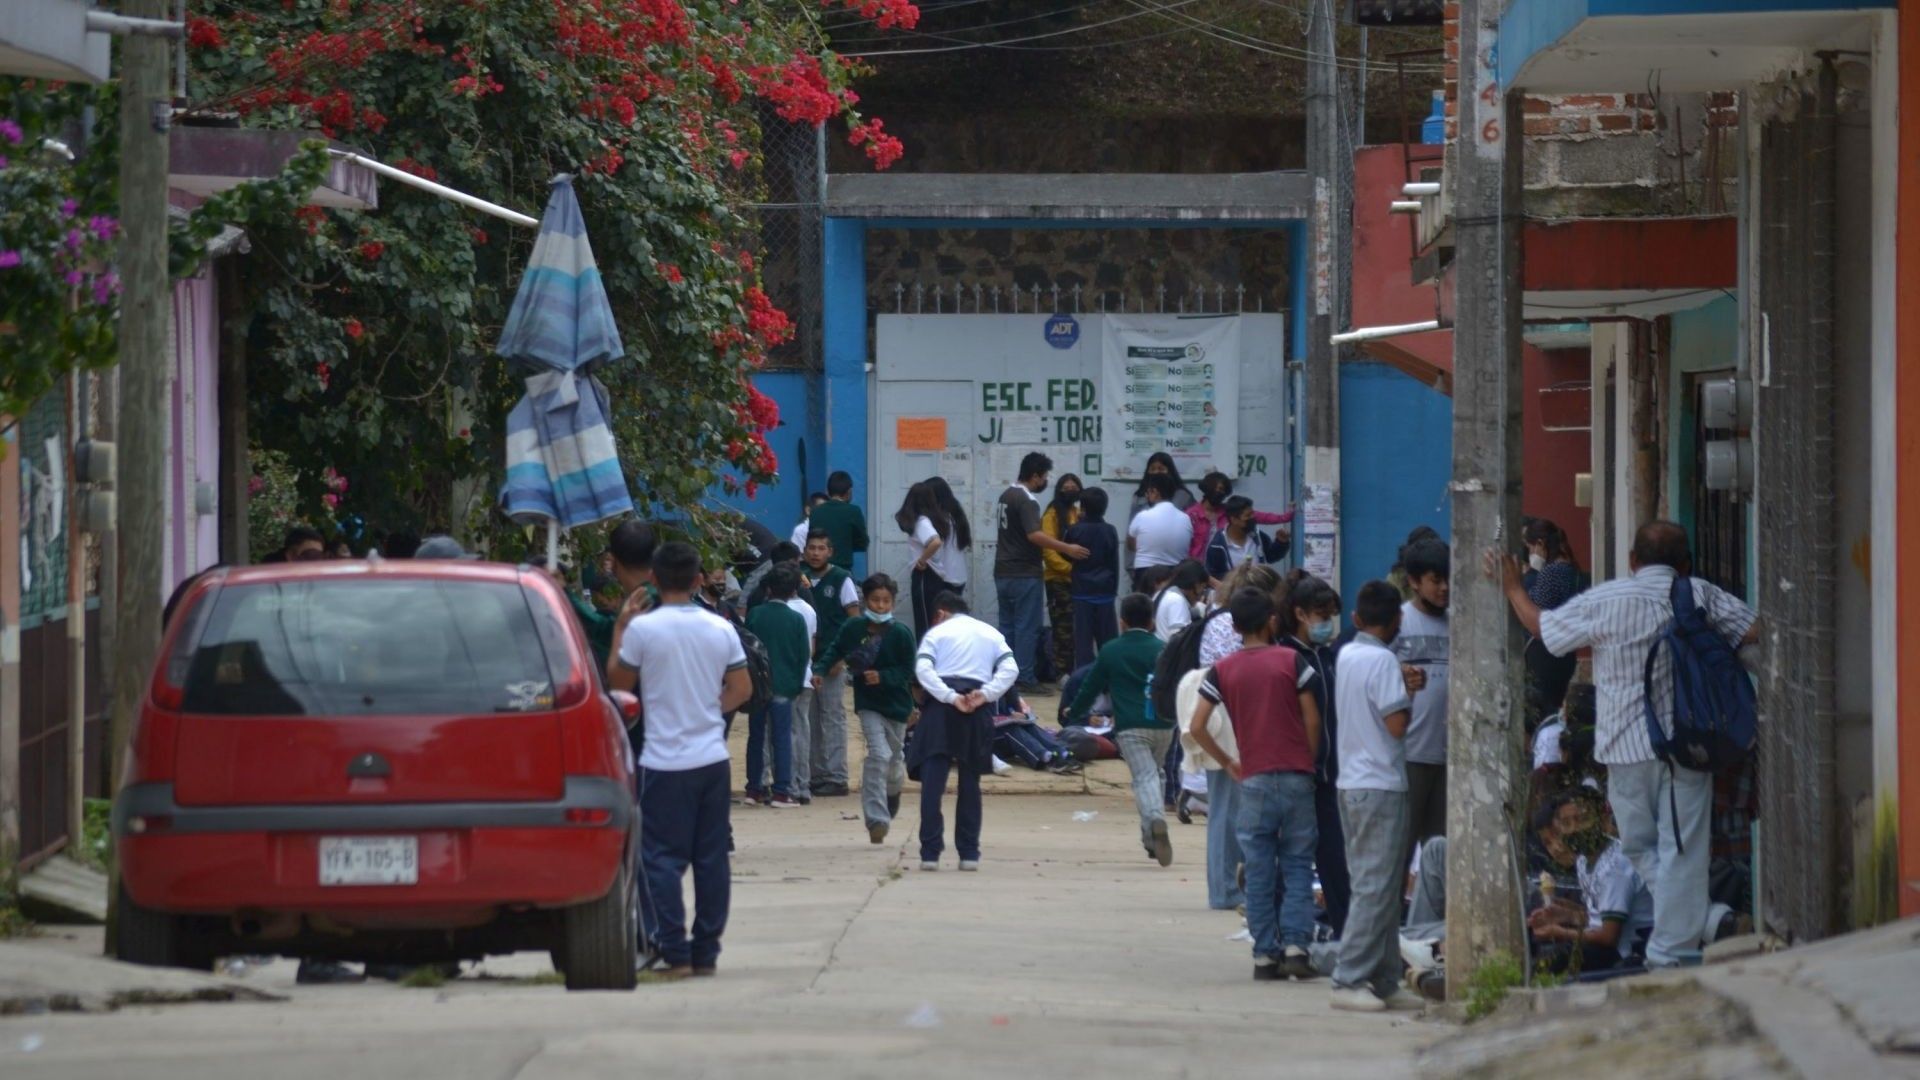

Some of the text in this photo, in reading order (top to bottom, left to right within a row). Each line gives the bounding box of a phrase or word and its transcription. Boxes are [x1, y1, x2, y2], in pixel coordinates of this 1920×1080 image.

[1050, 322, 1074, 335] ADT
[1168, 367, 1182, 375] No
[1168, 384, 1182, 392] No
[983, 379, 1098, 411] ESC. FED.
[1168, 403, 1182, 411] No
[1168, 421, 1182, 429] No
[1165, 439, 1180, 447] No
